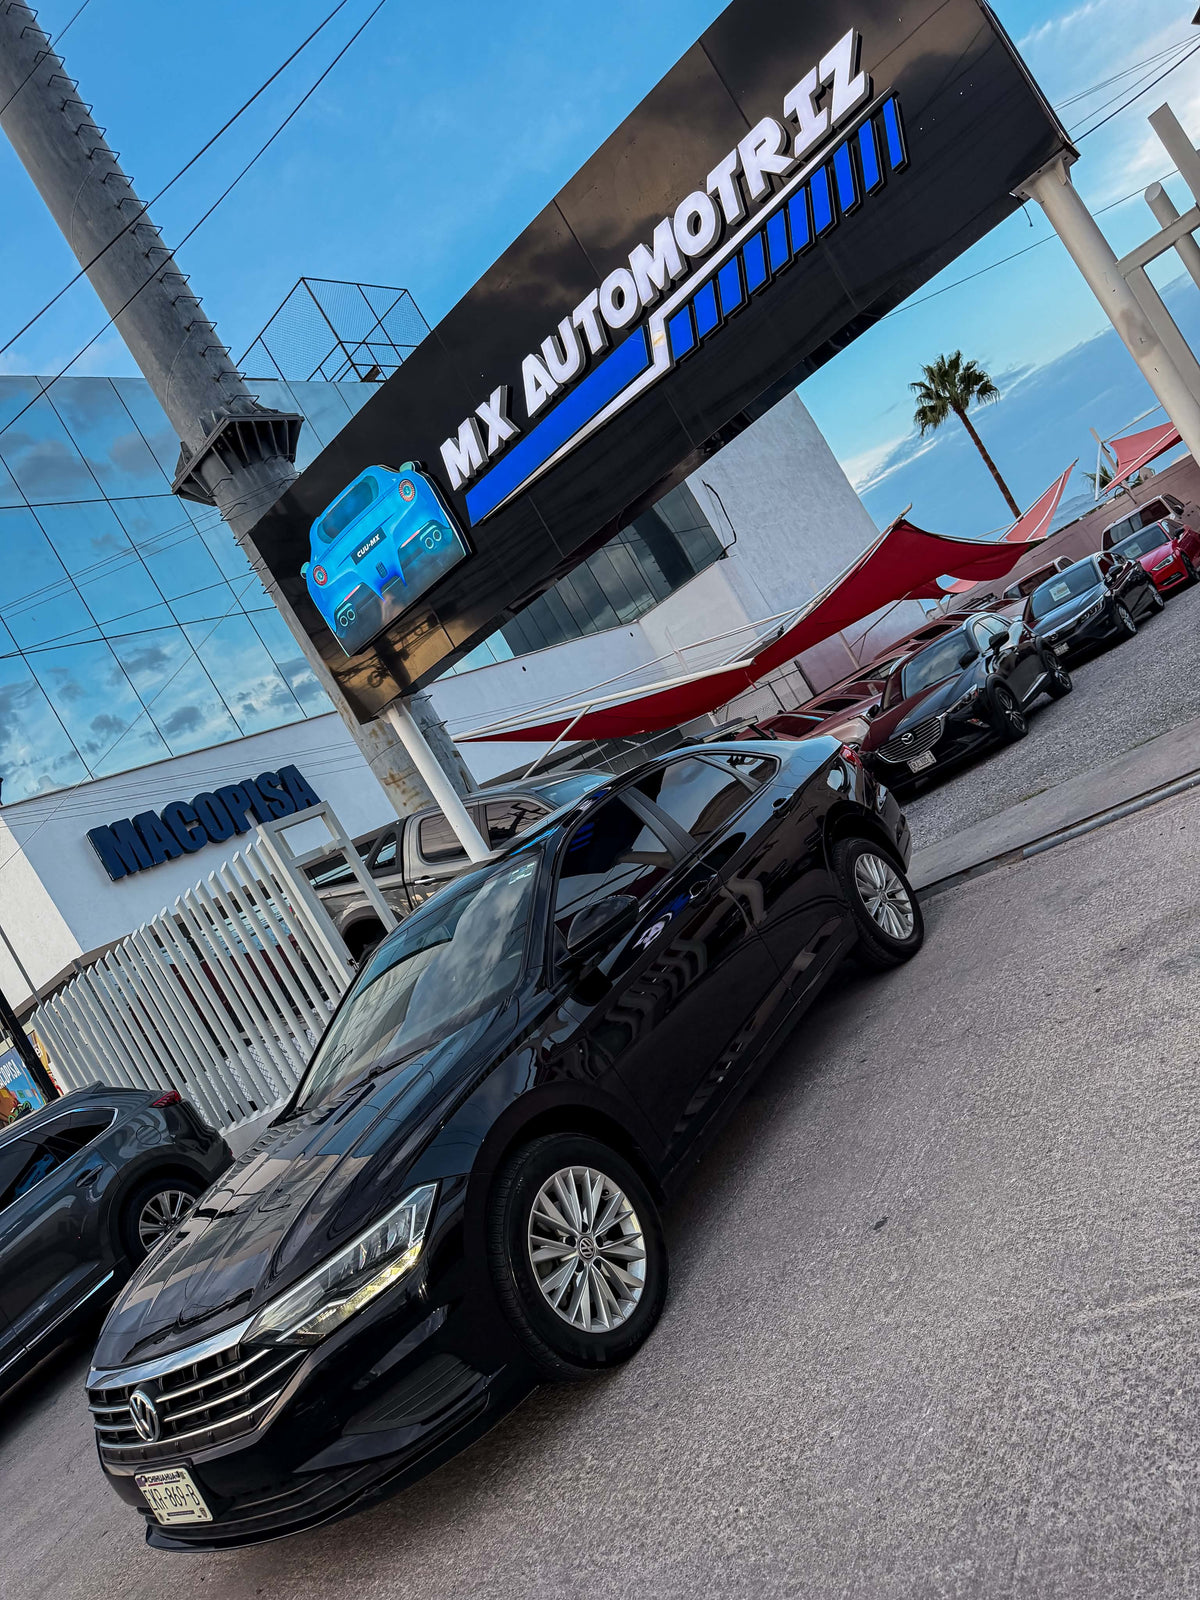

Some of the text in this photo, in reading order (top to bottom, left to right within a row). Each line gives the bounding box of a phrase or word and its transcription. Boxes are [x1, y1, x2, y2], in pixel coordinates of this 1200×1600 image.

[439, 27, 870, 492] MX AUTOMOTRIZ
[84, 763, 322, 882] MACOPISA
[143, 1483, 201, 1511] EKR-869-B
